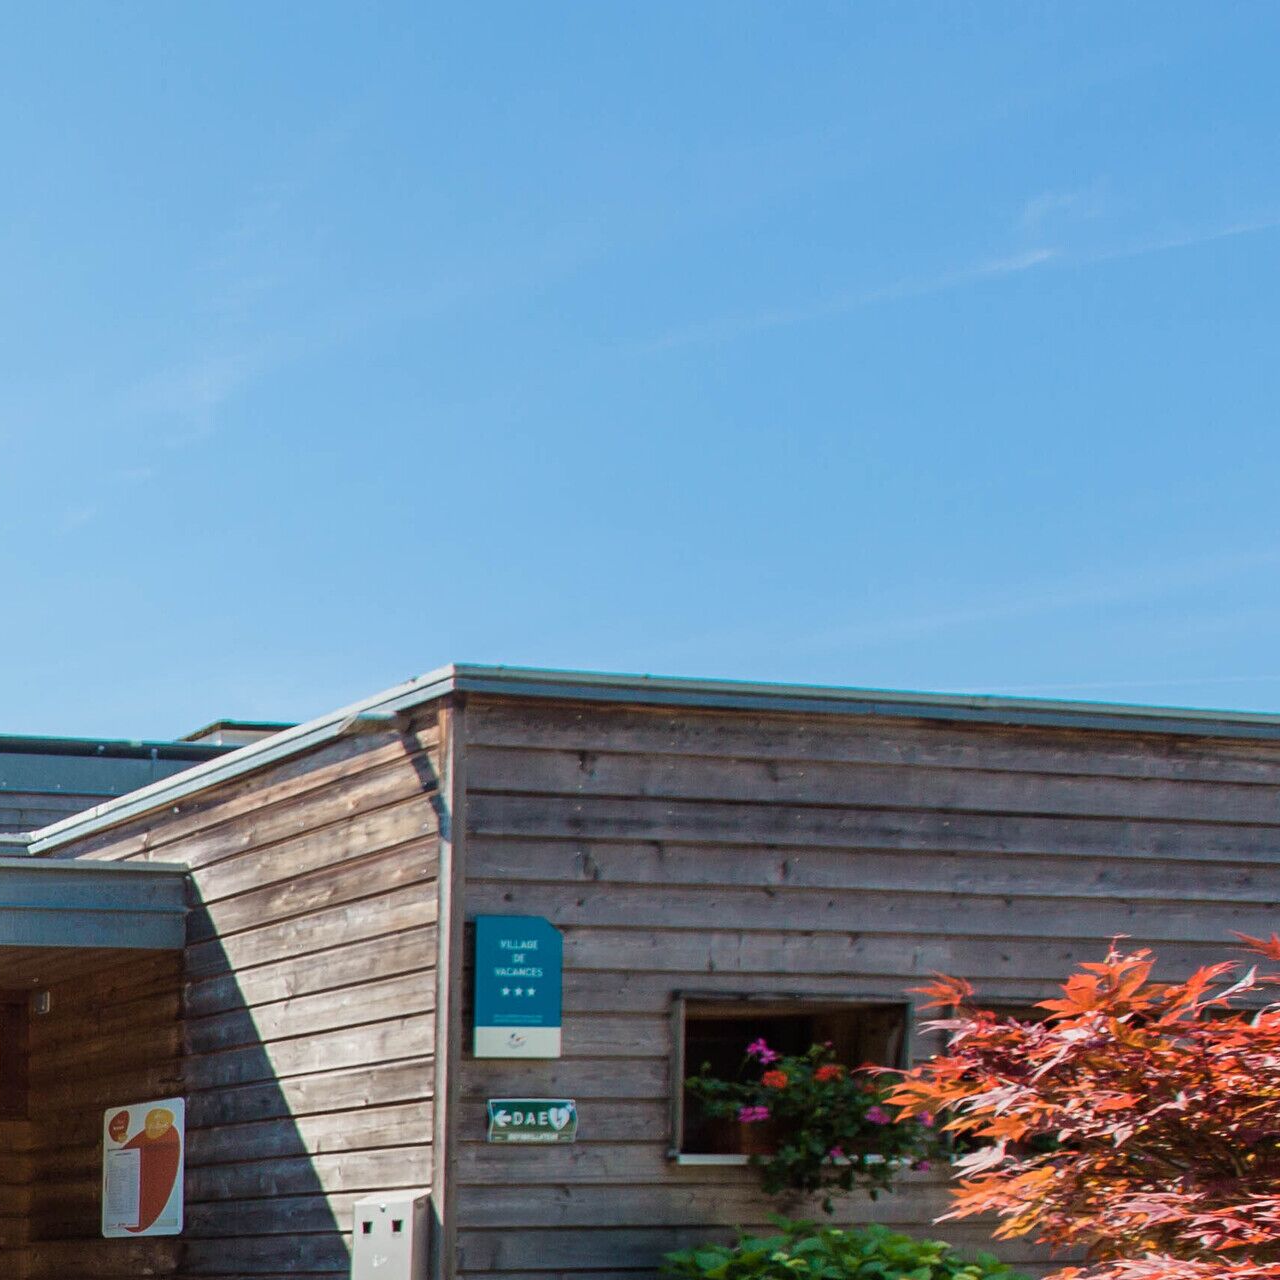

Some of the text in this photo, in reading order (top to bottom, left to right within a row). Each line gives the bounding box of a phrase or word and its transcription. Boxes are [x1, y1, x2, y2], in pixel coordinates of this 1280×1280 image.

[500, 940, 538, 949] VILLAGE
[513, 953, 525, 963] DE
[494, 967, 543, 977] VACANCES
[512, 1111, 548, 1126] DAE
